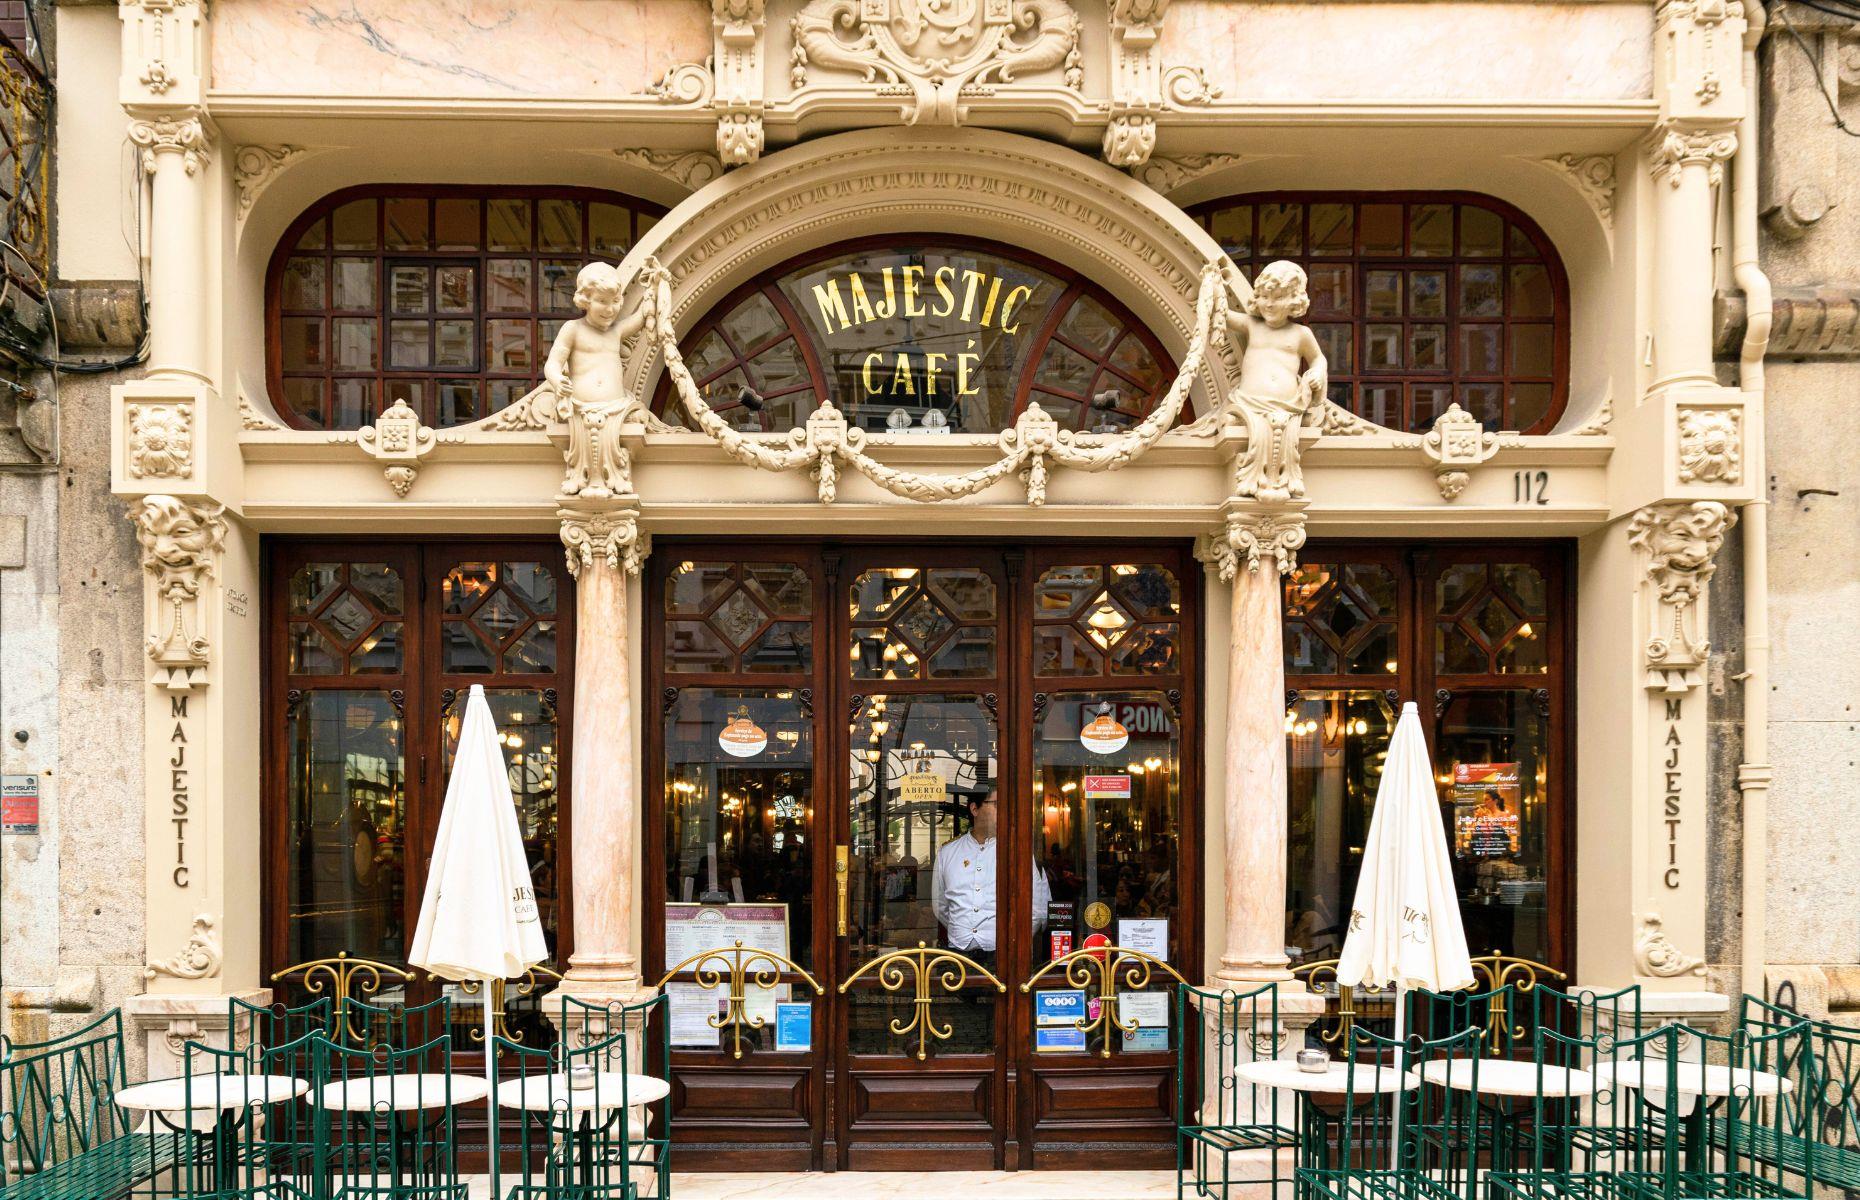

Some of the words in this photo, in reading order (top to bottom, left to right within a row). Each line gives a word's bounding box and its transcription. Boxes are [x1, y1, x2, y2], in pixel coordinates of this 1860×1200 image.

[812, 265, 1032, 335] MAJESTIC
[862, 339, 980, 395] CAFÉ
[1514, 471, 1549, 505] 112
[171, 695, 188, 888] MAJESTIC
[1665, 699, 1682, 889] MAJESTIC
